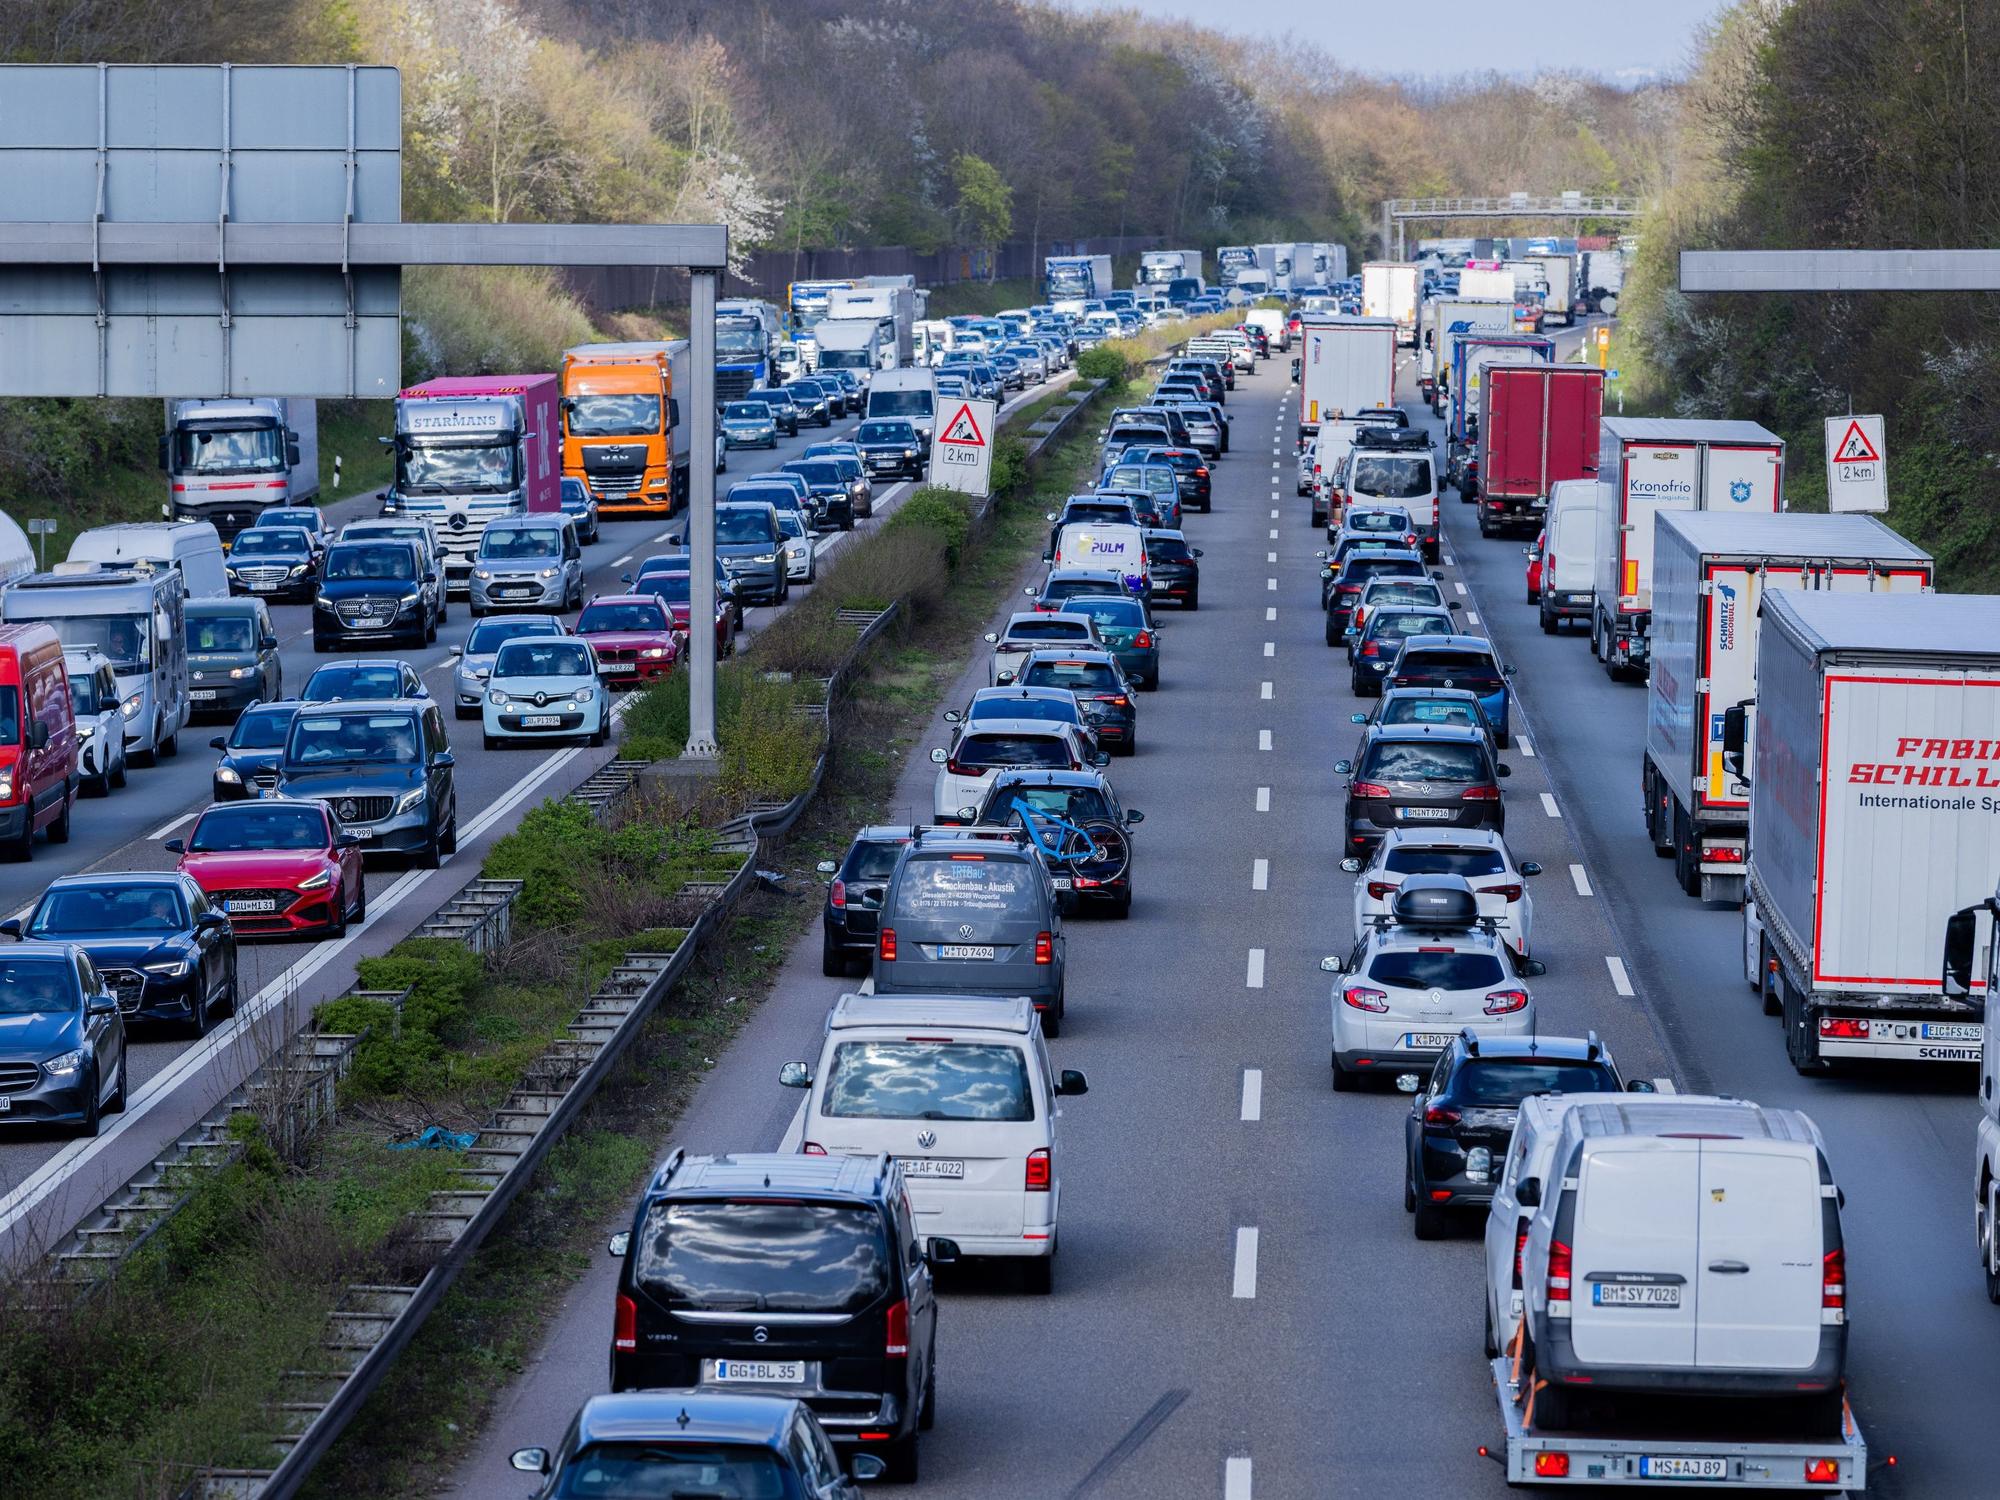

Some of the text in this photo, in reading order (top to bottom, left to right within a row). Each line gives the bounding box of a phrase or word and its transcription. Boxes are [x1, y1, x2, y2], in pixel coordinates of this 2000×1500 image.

[414, 415, 496, 428] STARMANS
[948, 448, 975, 463] 2 km
[1844, 466, 1871, 479] 2 km
[1091, 542, 1125, 553] PULM
[1720, 602, 1728, 650] SCHMITZ
[1727, 602, 1735, 651] CARGOBULL
[1848, 764, 2000, 788] SCHILL
[1859, 793, 1975, 810] Internationale
[357, 829, 371, 838] 999
[988, 881, 1015, 893] Akustik
[1057, 879, 1070, 888] 108
[263, 901, 273, 910] 31
[943, 947, 950, 956] W
[970, 947, 993, 958] 7494
[1929, 1026, 1980, 1038] EIC FS 425
[1415, 1035, 1422, 1045] K
[919, 1162, 932, 1173] AF
[935, 1162, 962, 1175] 4022
[1602, 1286, 1678, 1302] BM SY 7028
[730, 1364, 796, 1379] GG BL 35
[1654, 1460, 1721, 1475] MS AJ 89
